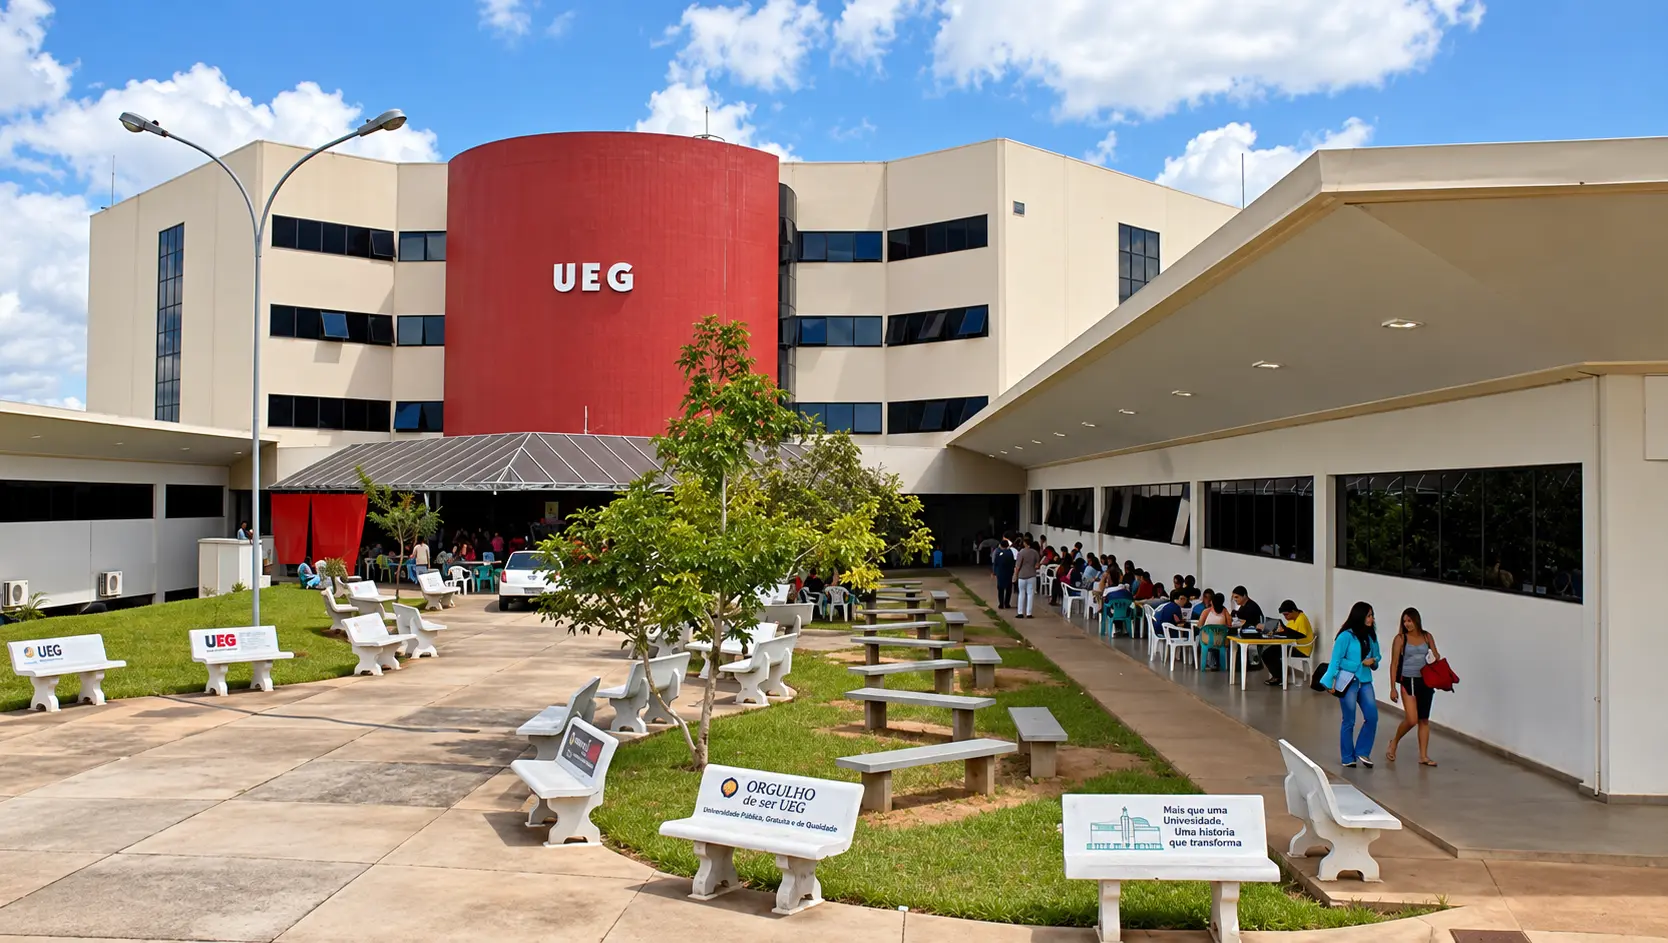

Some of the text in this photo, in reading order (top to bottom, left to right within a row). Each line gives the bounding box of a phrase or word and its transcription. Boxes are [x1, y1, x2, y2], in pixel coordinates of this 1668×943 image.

[553, 262, 634, 293] UEG
[205, 633, 237, 649] UEG
[37, 644, 63, 658] UEG
[746, 780, 816, 801] ORGULHO
[742, 795, 807, 814] de ser UEG
[1163, 805, 1186, 814] Mais
[1187, 807, 1205, 816] que
[796, 820, 805, 828] de
[1174, 827, 1235, 836] Uma historia
[1169, 838, 1242, 849] que transforma
